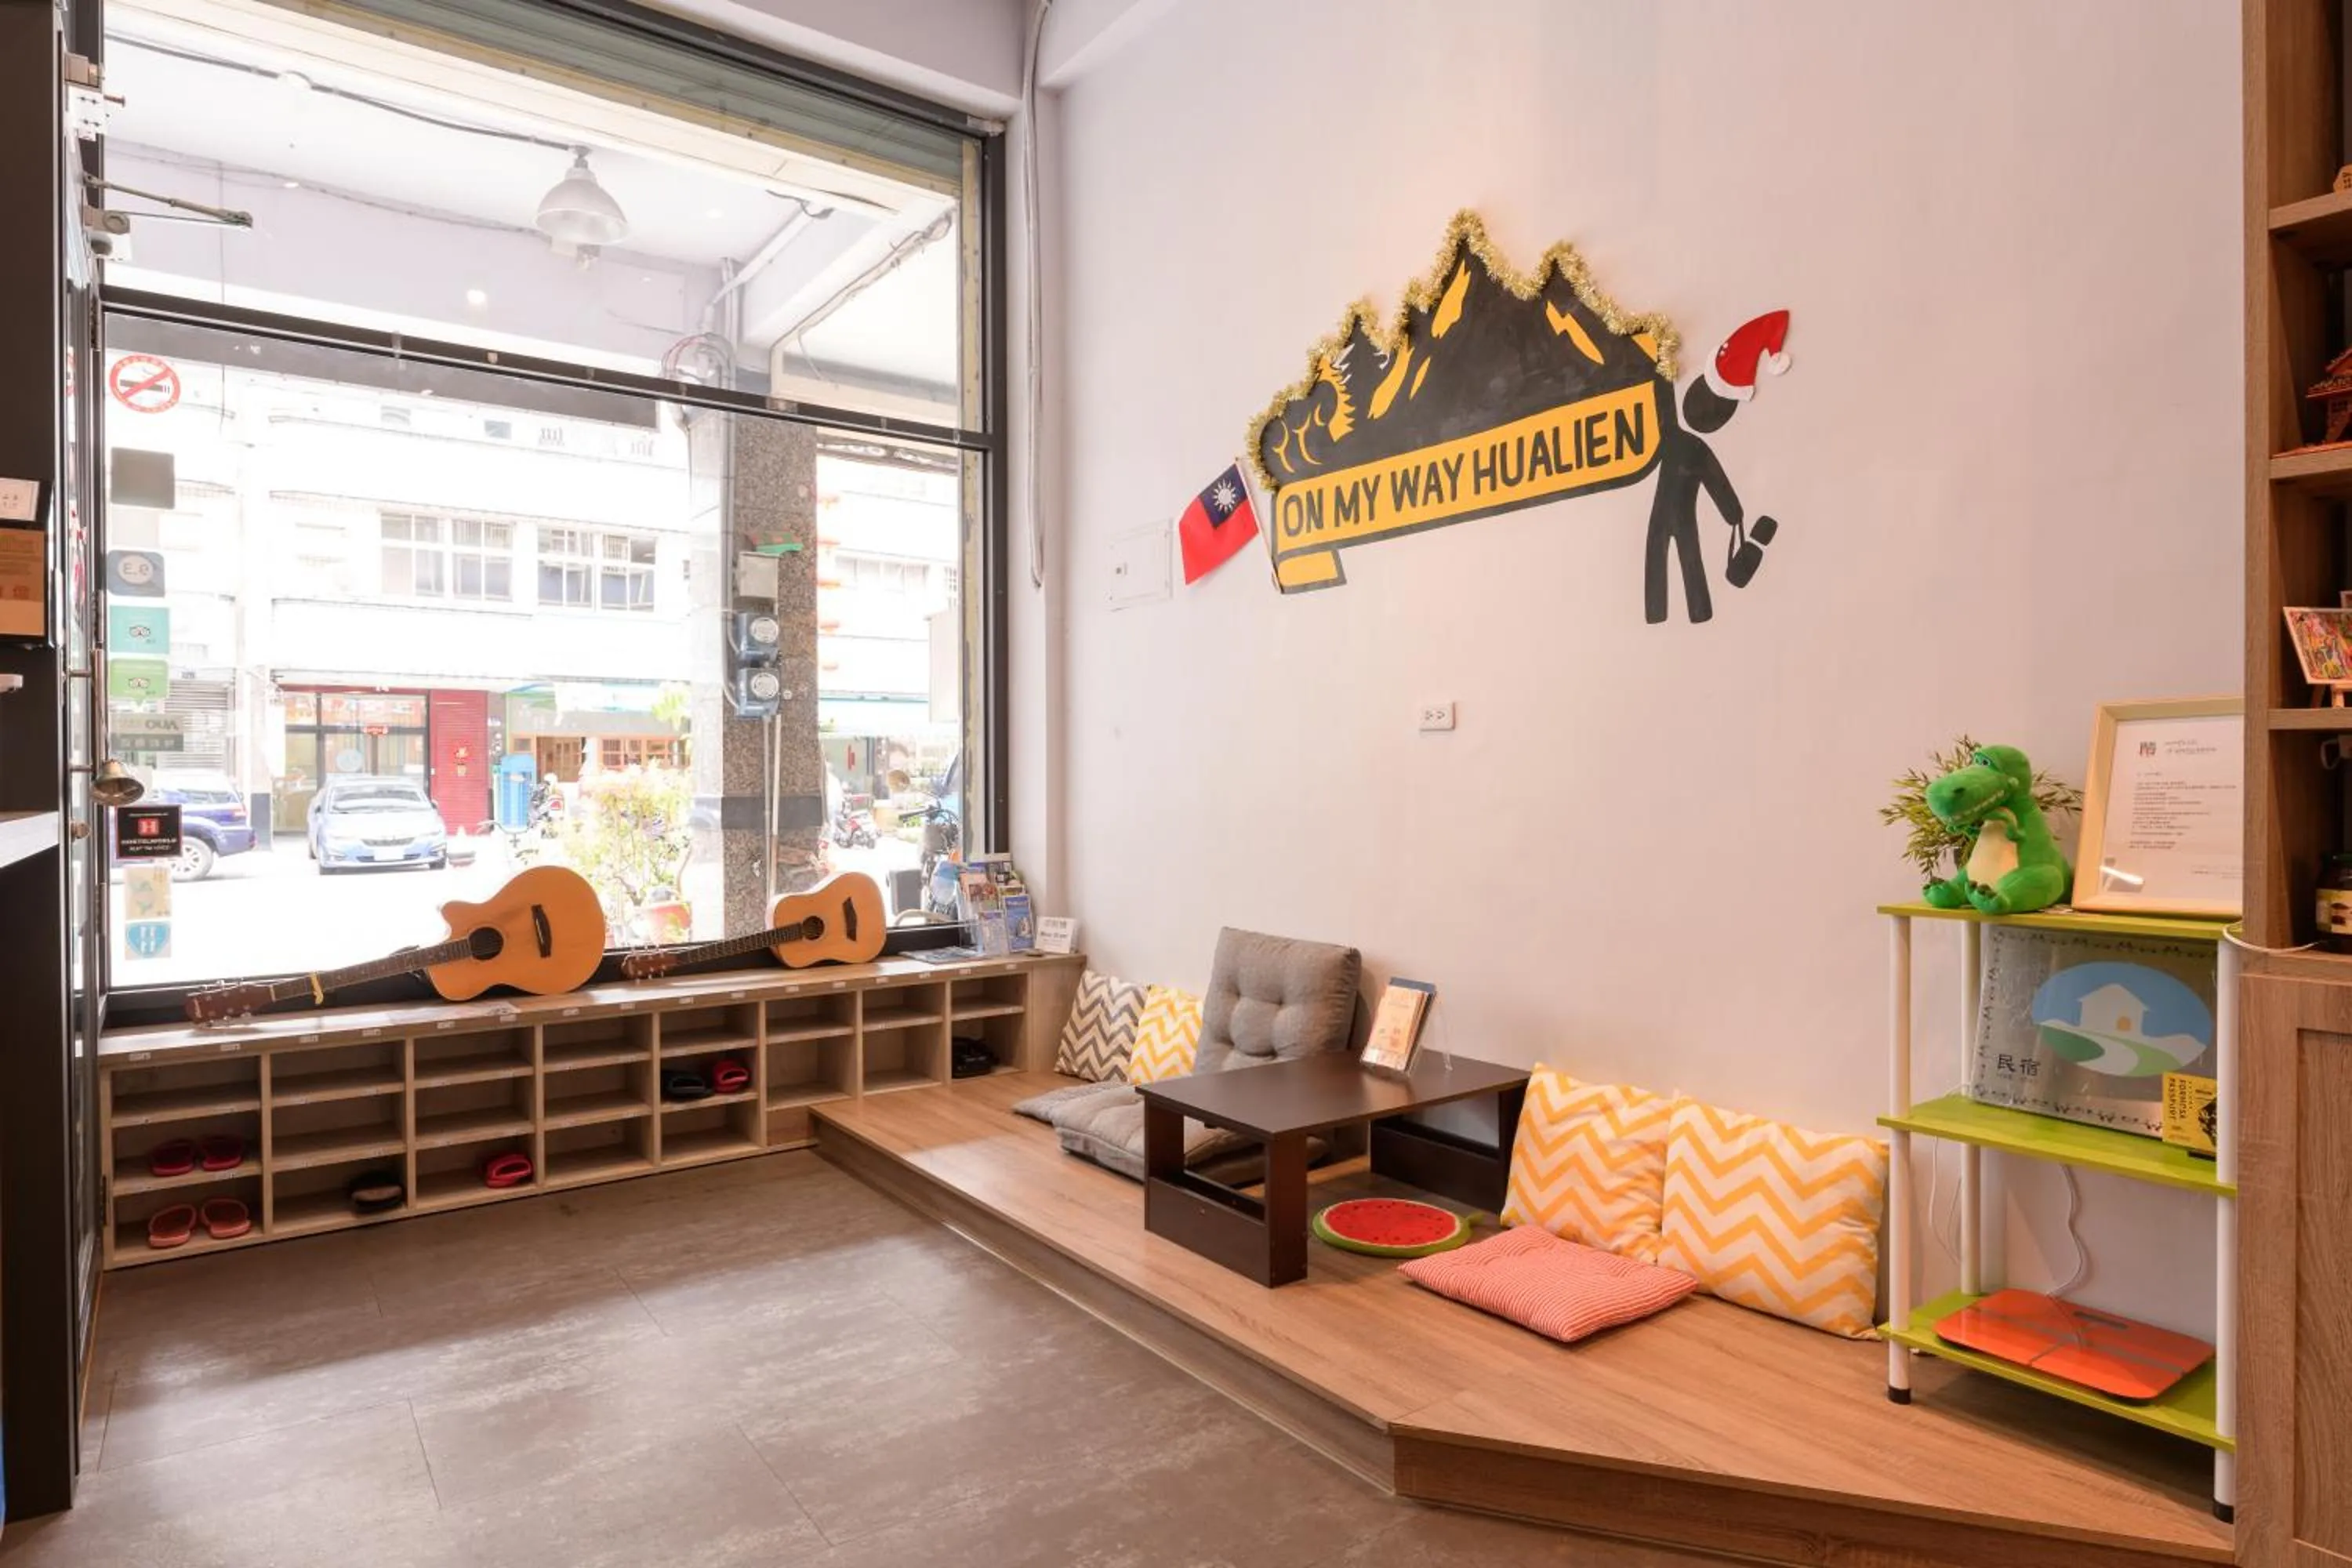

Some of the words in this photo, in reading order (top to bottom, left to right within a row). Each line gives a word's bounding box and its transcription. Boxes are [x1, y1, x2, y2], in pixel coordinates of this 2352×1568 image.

[1283, 488, 1323, 537] ON
[1334, 474, 1381, 527] MY
[1391, 452, 1465, 513] WAY
[1473, 402, 1644, 495] HUALIEN
[1998, 1053, 2041, 1077] 民宿
